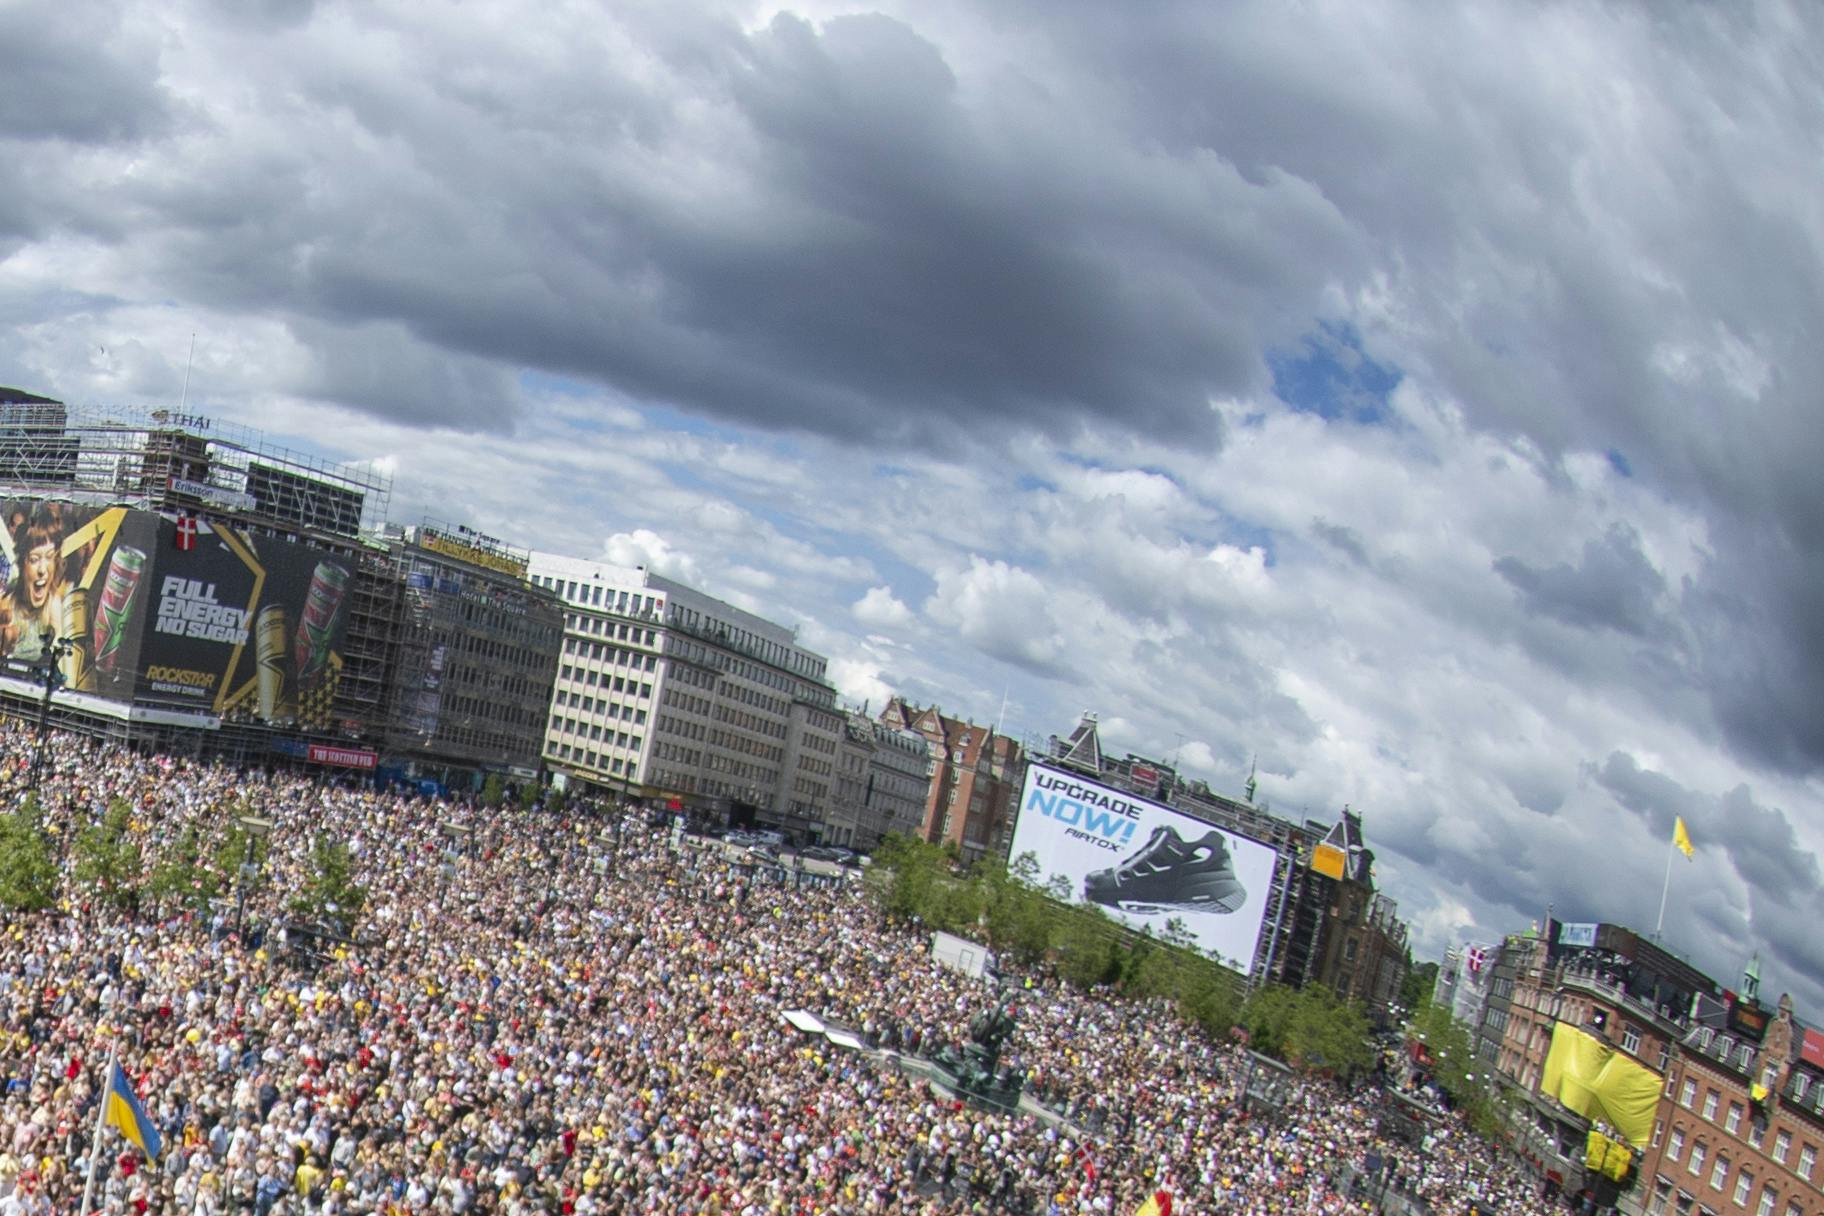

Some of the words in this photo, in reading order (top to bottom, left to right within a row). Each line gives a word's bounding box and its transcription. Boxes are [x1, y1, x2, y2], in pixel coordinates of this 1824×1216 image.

[172, 413, 210, 429] THAI
[175, 480, 214, 498] Eriksson
[161, 576, 218, 604] FULL
[460, 590, 480, 602] Hotel
[158, 596, 253, 629] ENERGY
[155, 616, 186, 635] NO
[186, 621, 249, 645] SUGAR
[146, 665, 217, 688] ROCKSTAR
[151, 681, 181, 694] ENERGY
[1035, 773, 1144, 820] UPGRADE
[1026, 789, 1137, 844] NOW!
